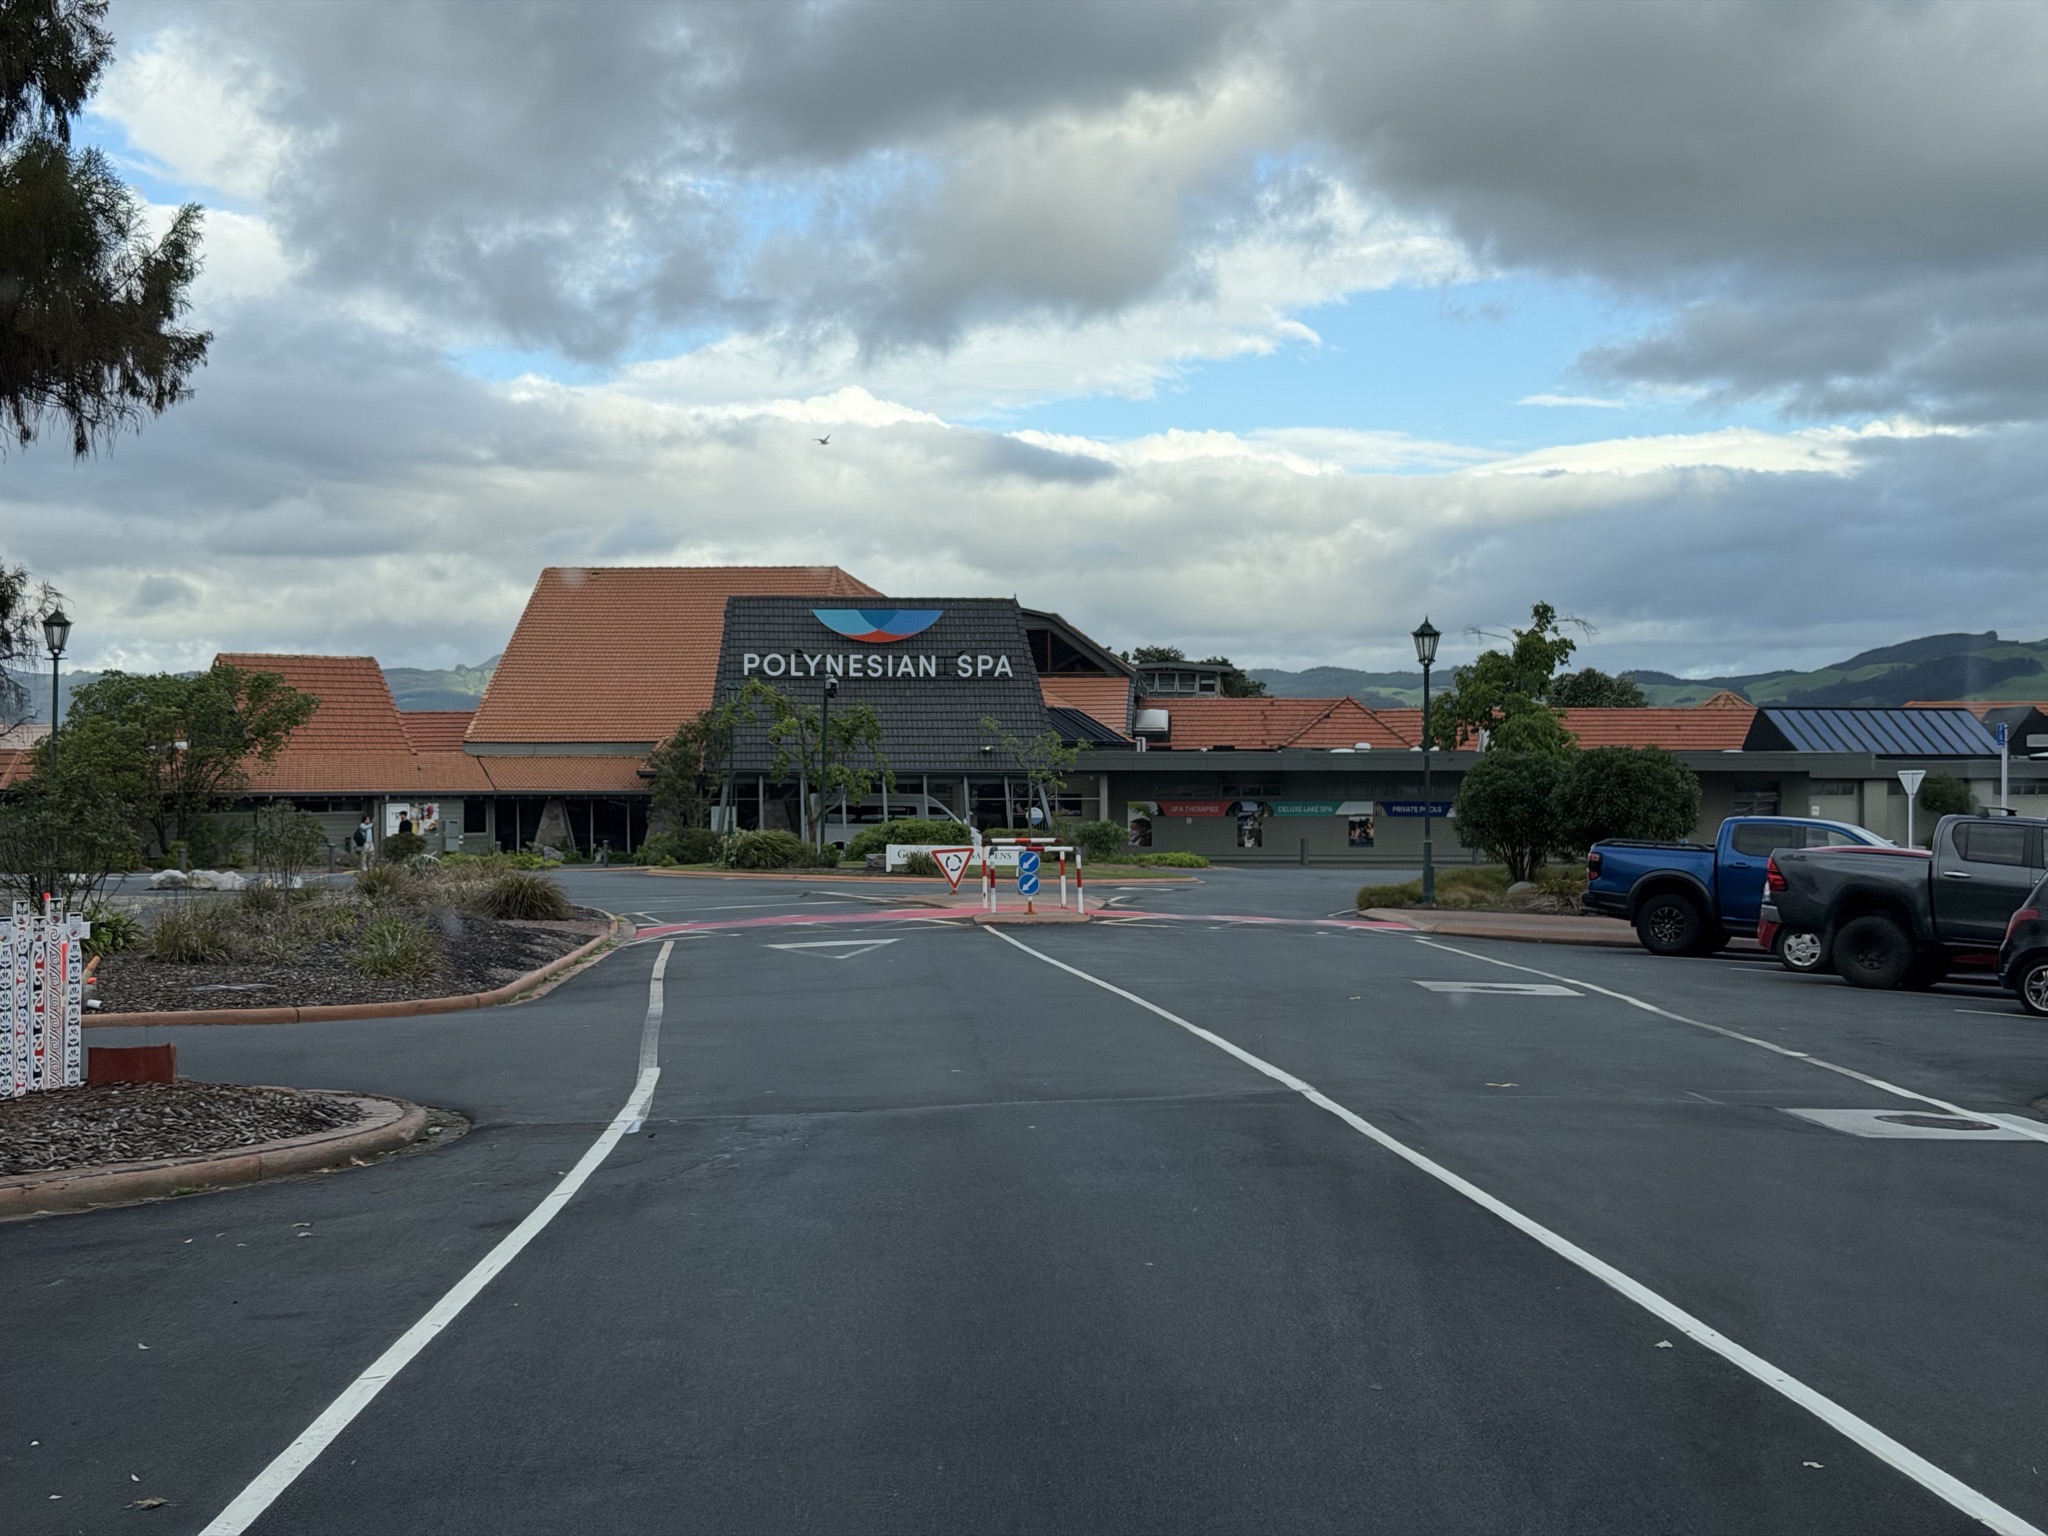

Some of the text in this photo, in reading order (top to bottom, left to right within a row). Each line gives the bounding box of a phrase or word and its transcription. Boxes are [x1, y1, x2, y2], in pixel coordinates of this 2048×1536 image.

[743, 653, 1013, 678] POLYNESIAN SPA
[1171, 805, 1219, 813] SPA THERAPIES
[1278, 805, 1333, 813] DELUXE LAKE SPA
[1392, 805, 1418, 813] PRIVATE
